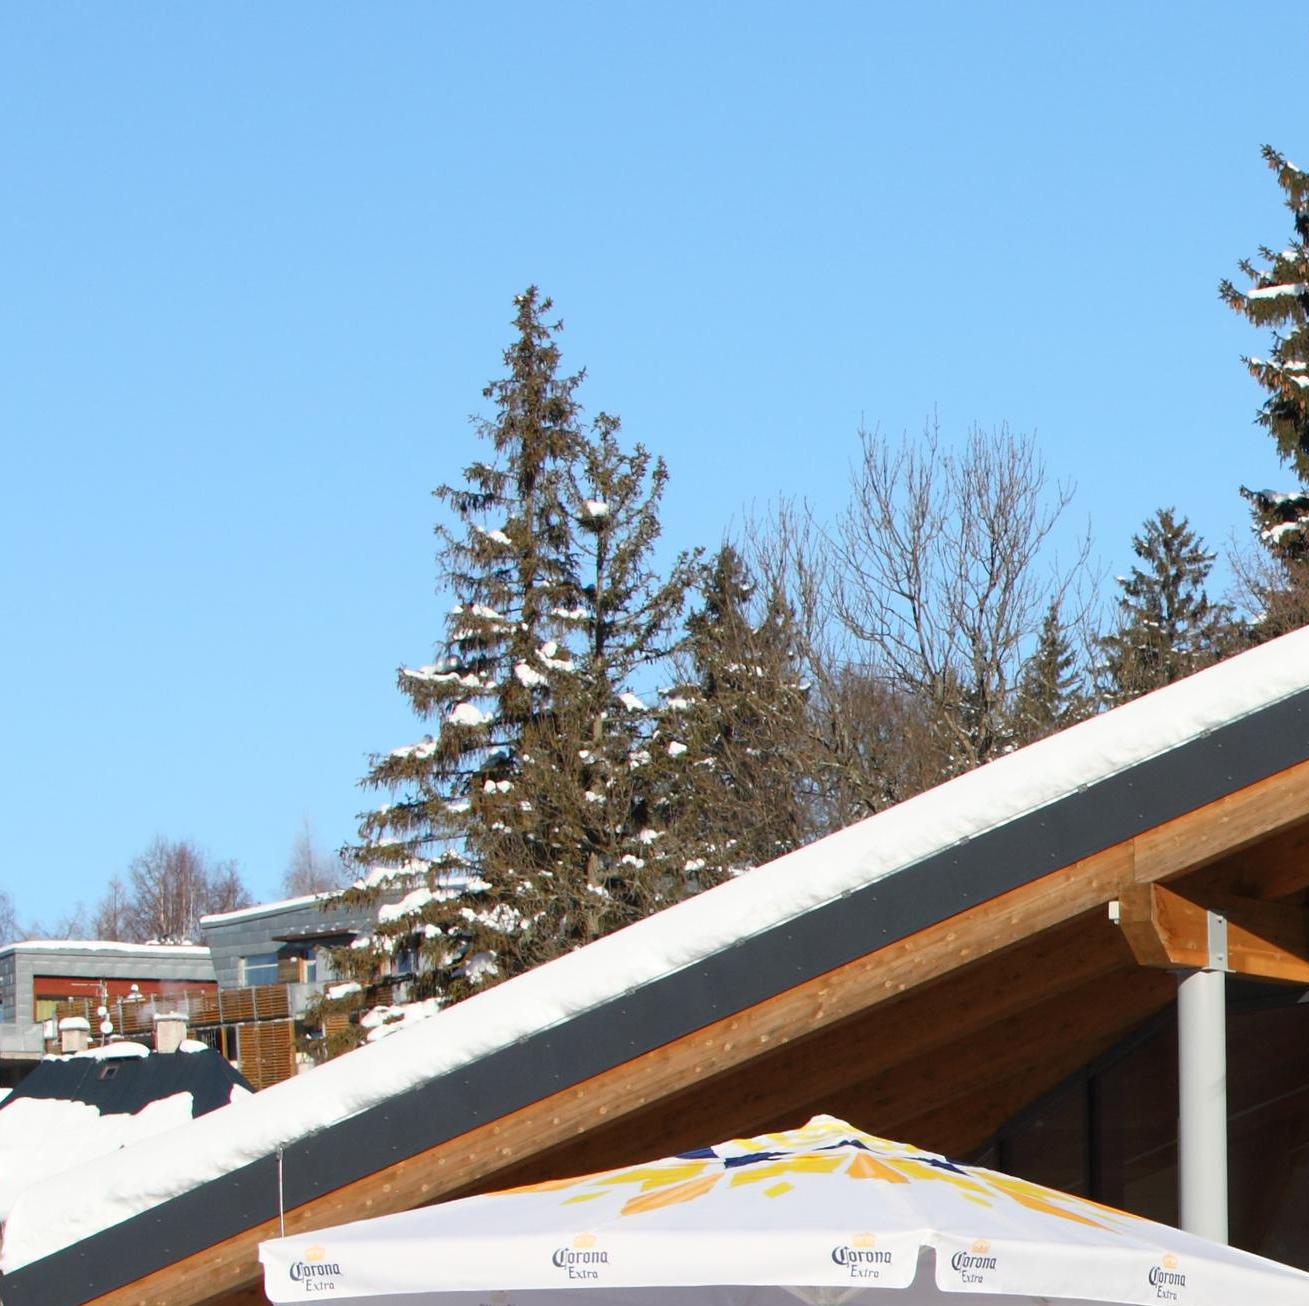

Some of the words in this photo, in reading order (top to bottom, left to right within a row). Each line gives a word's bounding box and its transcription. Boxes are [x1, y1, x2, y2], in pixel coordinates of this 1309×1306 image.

[552, 1248, 608, 1269] Corona
[831, 1246, 892, 1267] Corona
[951, 1250, 998, 1271] Corona
[289, 1261, 342, 1282] Corona
[568, 1266, 598, 1279] Extra
[850, 1265, 880, 1278] Extra
[961, 1269, 984, 1283] Extra
[1148, 1266, 1186, 1287] Corona
[306, 1279, 335, 1292] Extra
[1156, 1285, 1178, 1300] Extra
